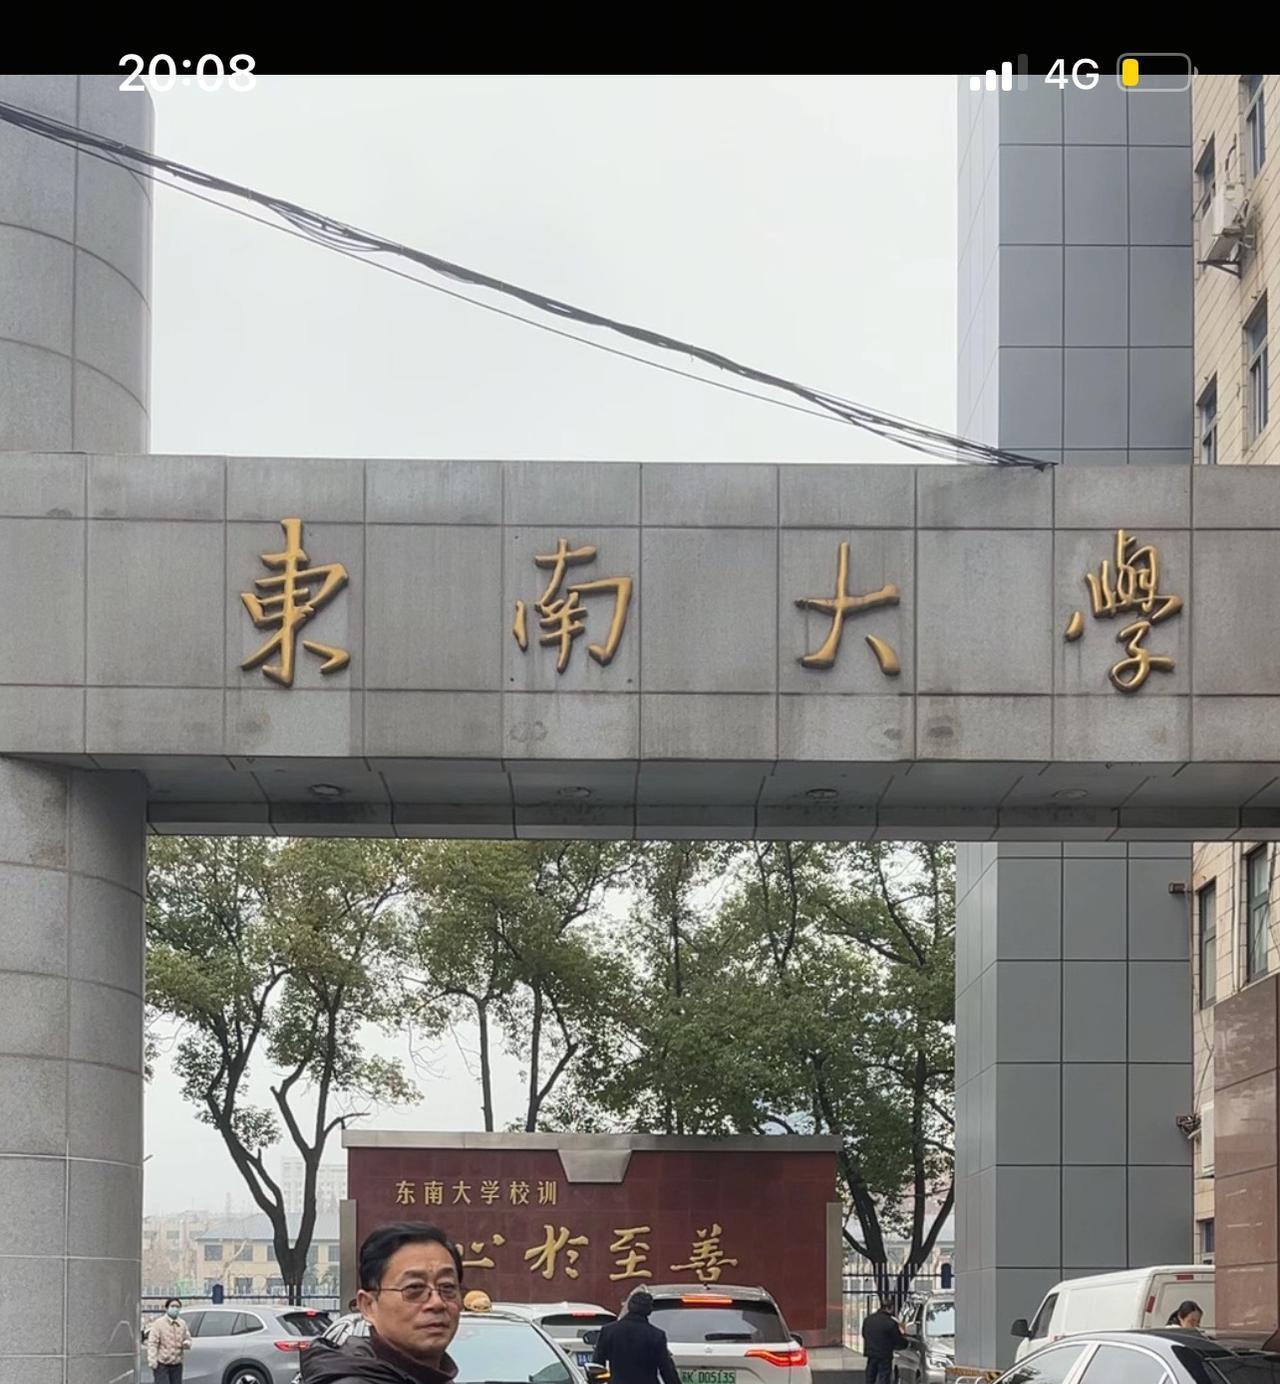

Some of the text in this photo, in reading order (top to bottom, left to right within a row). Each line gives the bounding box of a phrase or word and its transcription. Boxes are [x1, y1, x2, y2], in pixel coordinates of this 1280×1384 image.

[395, 1180, 558, 1206] 东南大学校训
